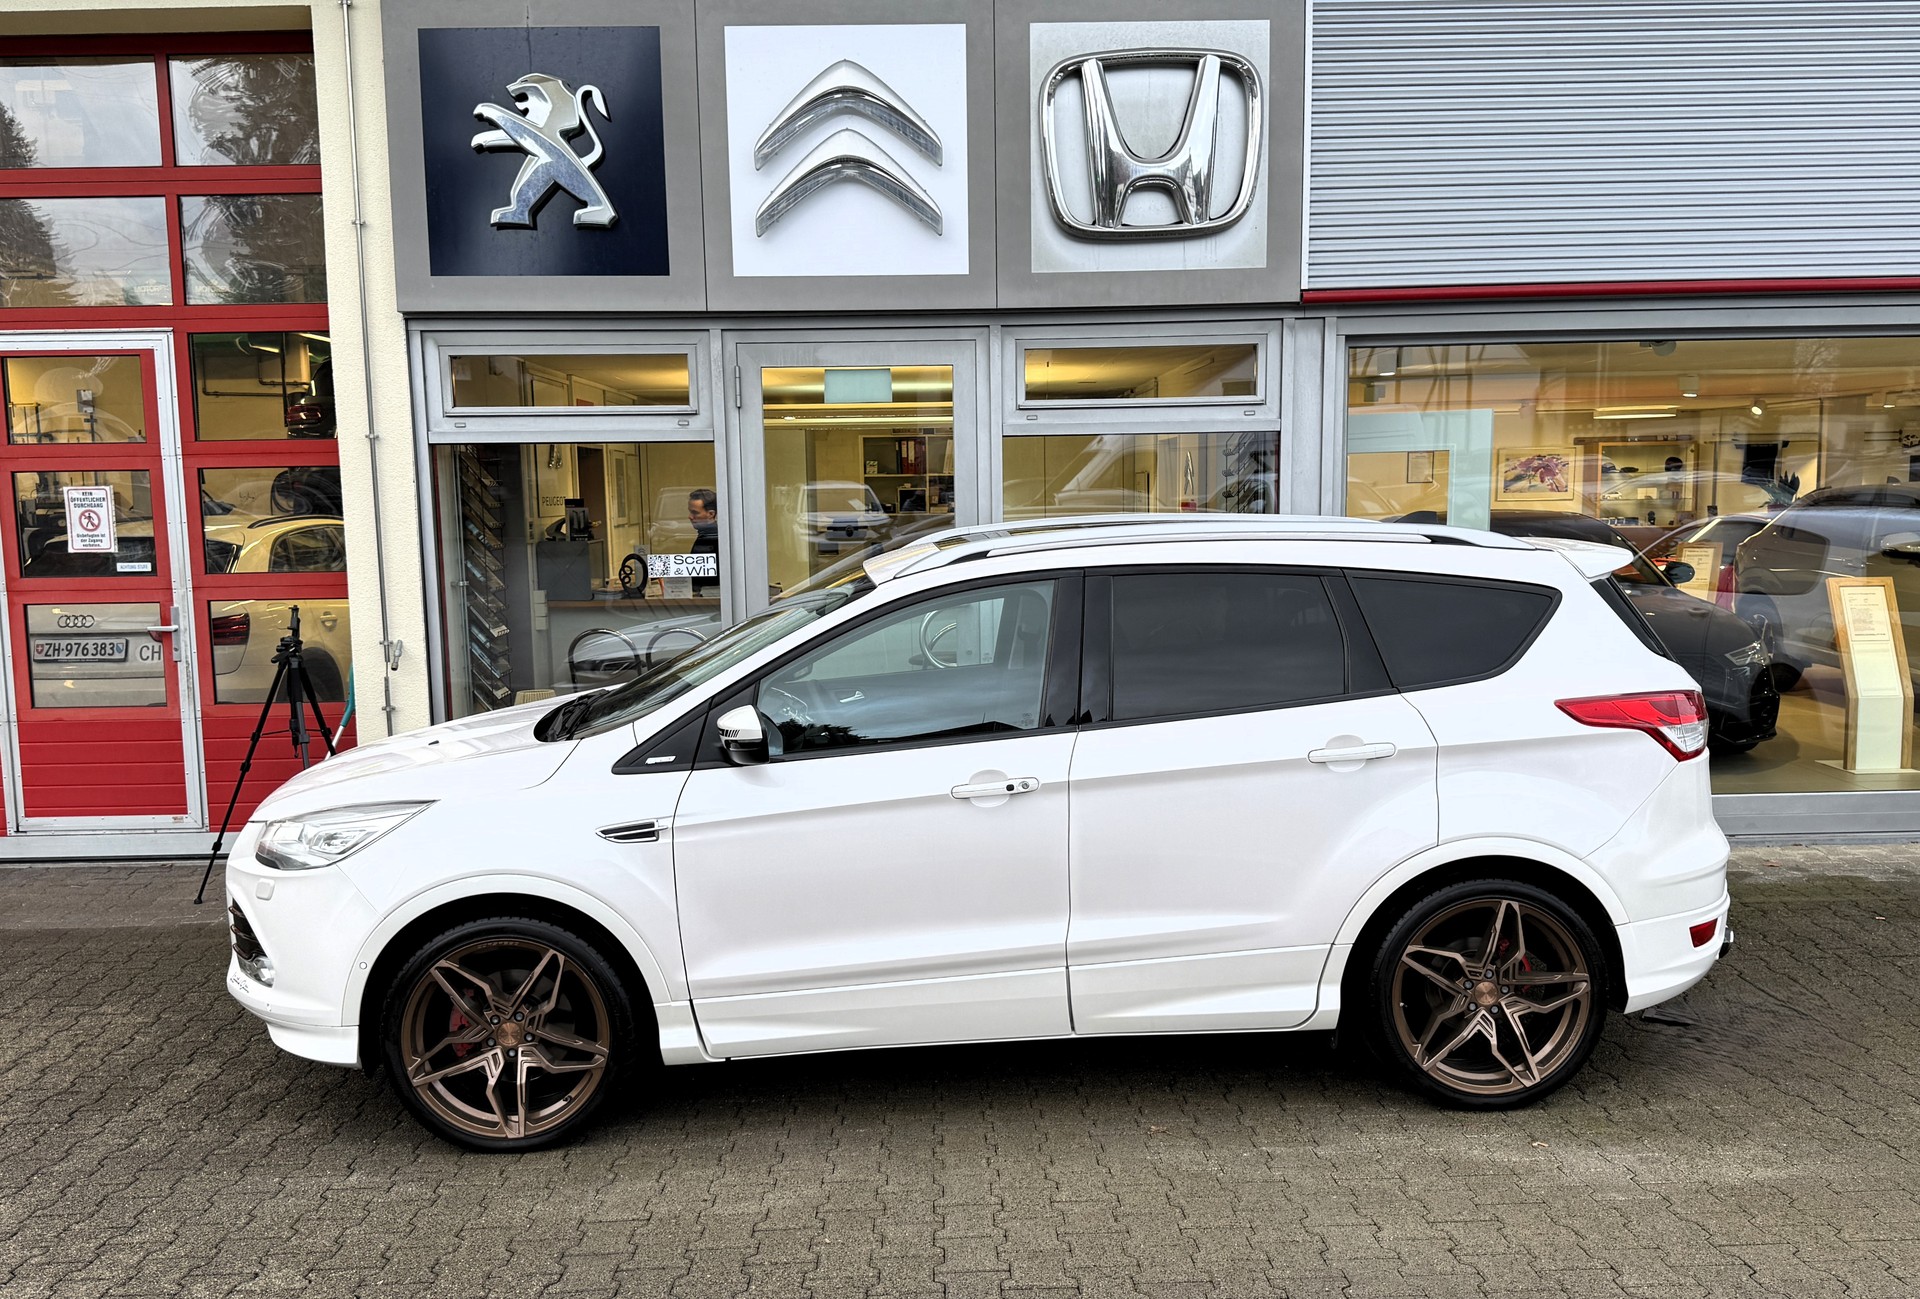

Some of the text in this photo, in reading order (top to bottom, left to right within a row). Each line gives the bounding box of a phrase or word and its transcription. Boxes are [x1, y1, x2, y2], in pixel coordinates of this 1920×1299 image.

[673, 554, 716, 565] Scan
[674, 564, 717, 576] & Win
[139, 645, 162, 661] CH
